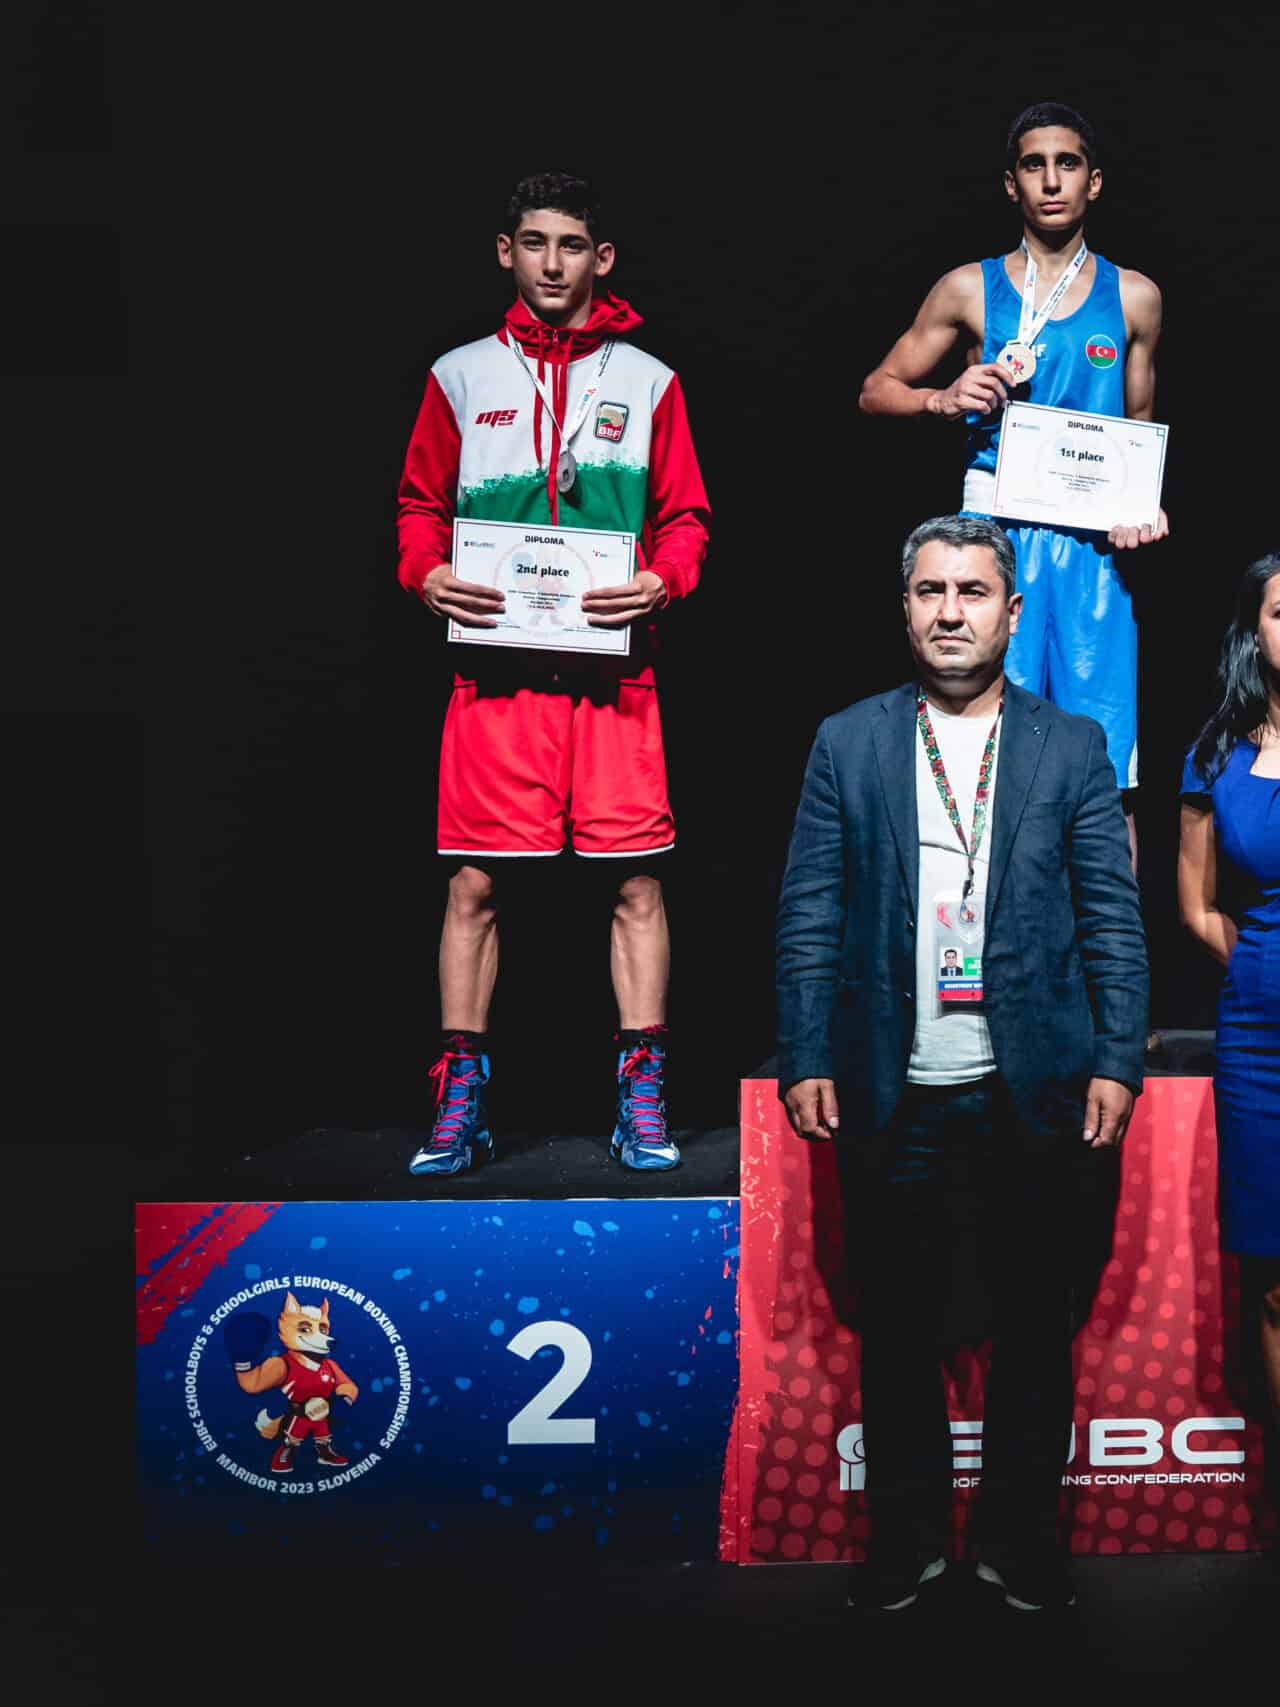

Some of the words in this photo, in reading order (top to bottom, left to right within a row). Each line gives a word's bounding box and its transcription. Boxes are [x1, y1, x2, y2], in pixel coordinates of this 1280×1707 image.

[1067, 420, 1104, 433] DIPLOMA
[1060, 447, 1076, 459] 1st
[1078, 448, 1105, 463] place
[524, 534, 565, 546] DIPLOMA
[516, 563, 538, 575] 2nd
[540, 564, 570, 578] place
[210, 1276, 291, 1326] SCHOOLGIRLS
[294, 1275, 366, 1305] EUROPEAN
[202, 1324, 214, 1336] &
[363, 1300, 402, 1344] BOXING
[185, 1335, 208, 1419] SCHOOLBOYS
[506, 1320, 596, 1445] 2
[379, 1344, 412, 1449] CHAMPIONSHIPS
[193, 1419, 218, 1452] EUBC
[216, 1453, 277, 1492] MARIBOR
[279, 1482, 315, 1494] 2023
[317, 1452, 383, 1492] SLOVENIA
[1094, 1472, 1246, 1485] CONFEDERATION
